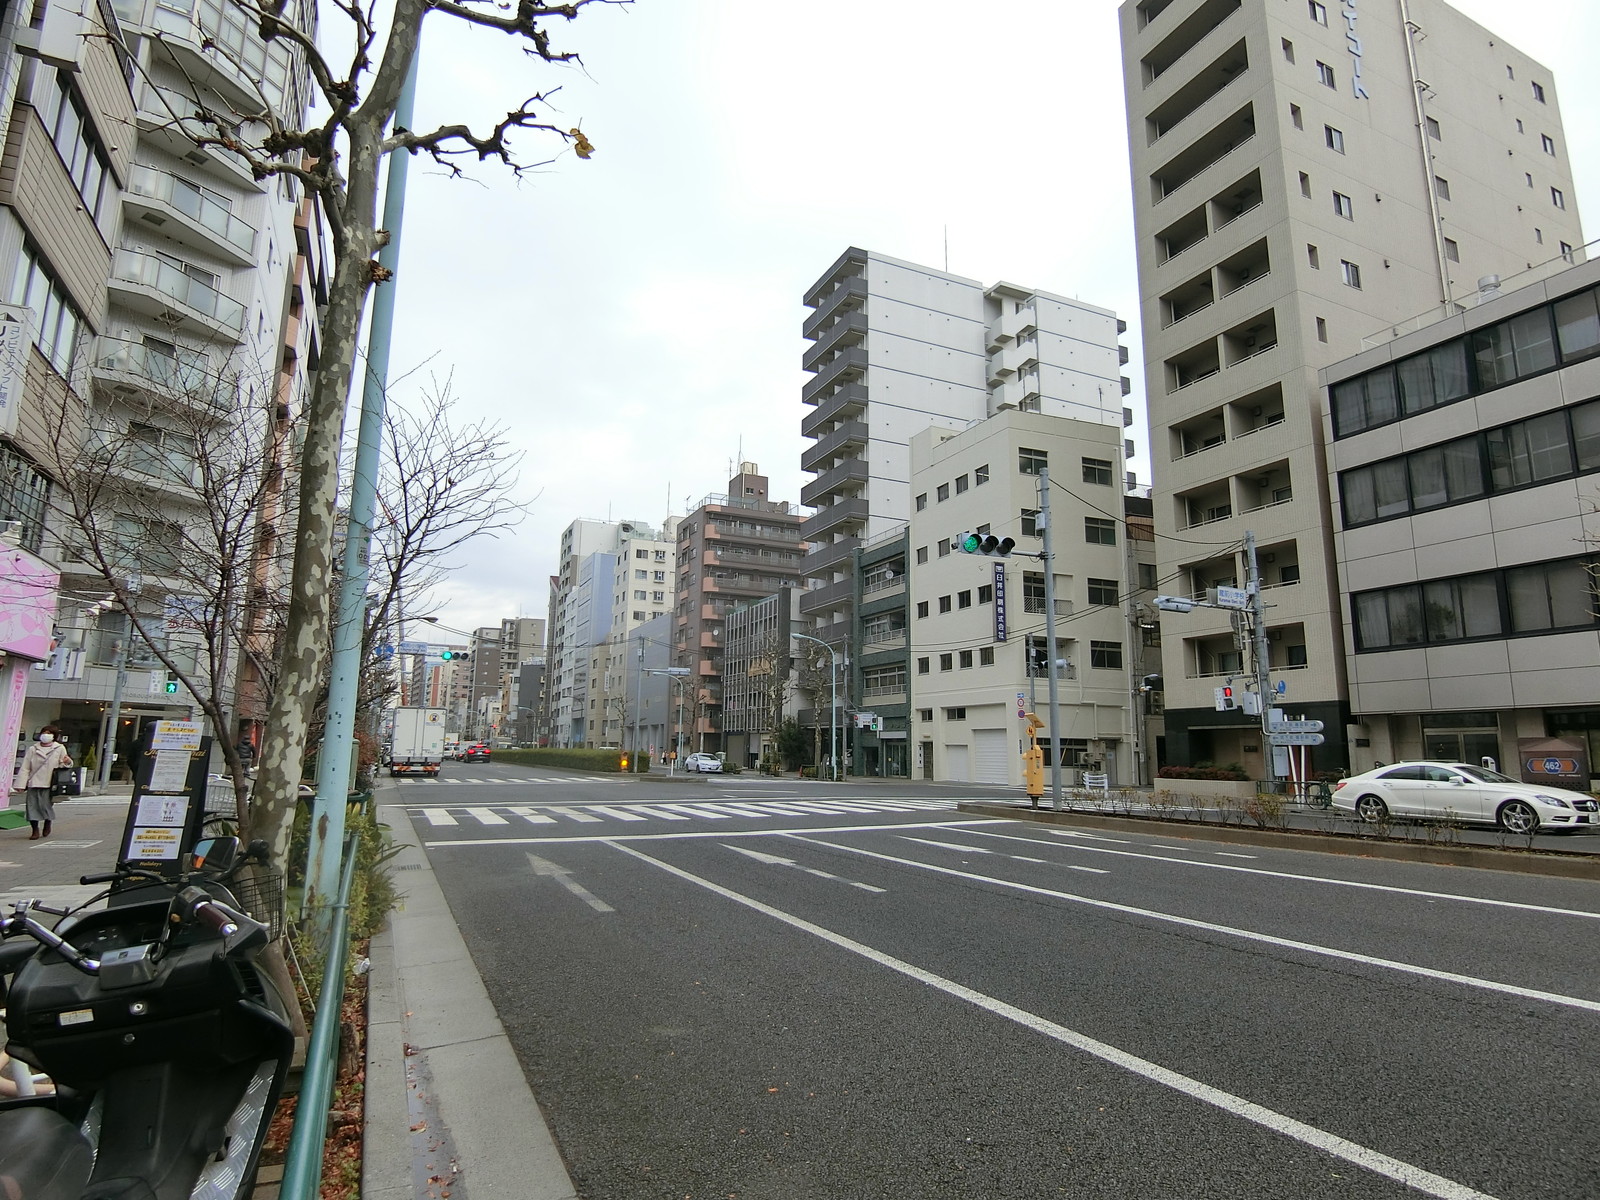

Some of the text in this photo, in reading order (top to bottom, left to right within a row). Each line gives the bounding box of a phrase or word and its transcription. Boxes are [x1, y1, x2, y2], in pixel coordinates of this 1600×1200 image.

[1340, 0, 1369, 99] イコート
[1544, 761, 1560, 770] 462
